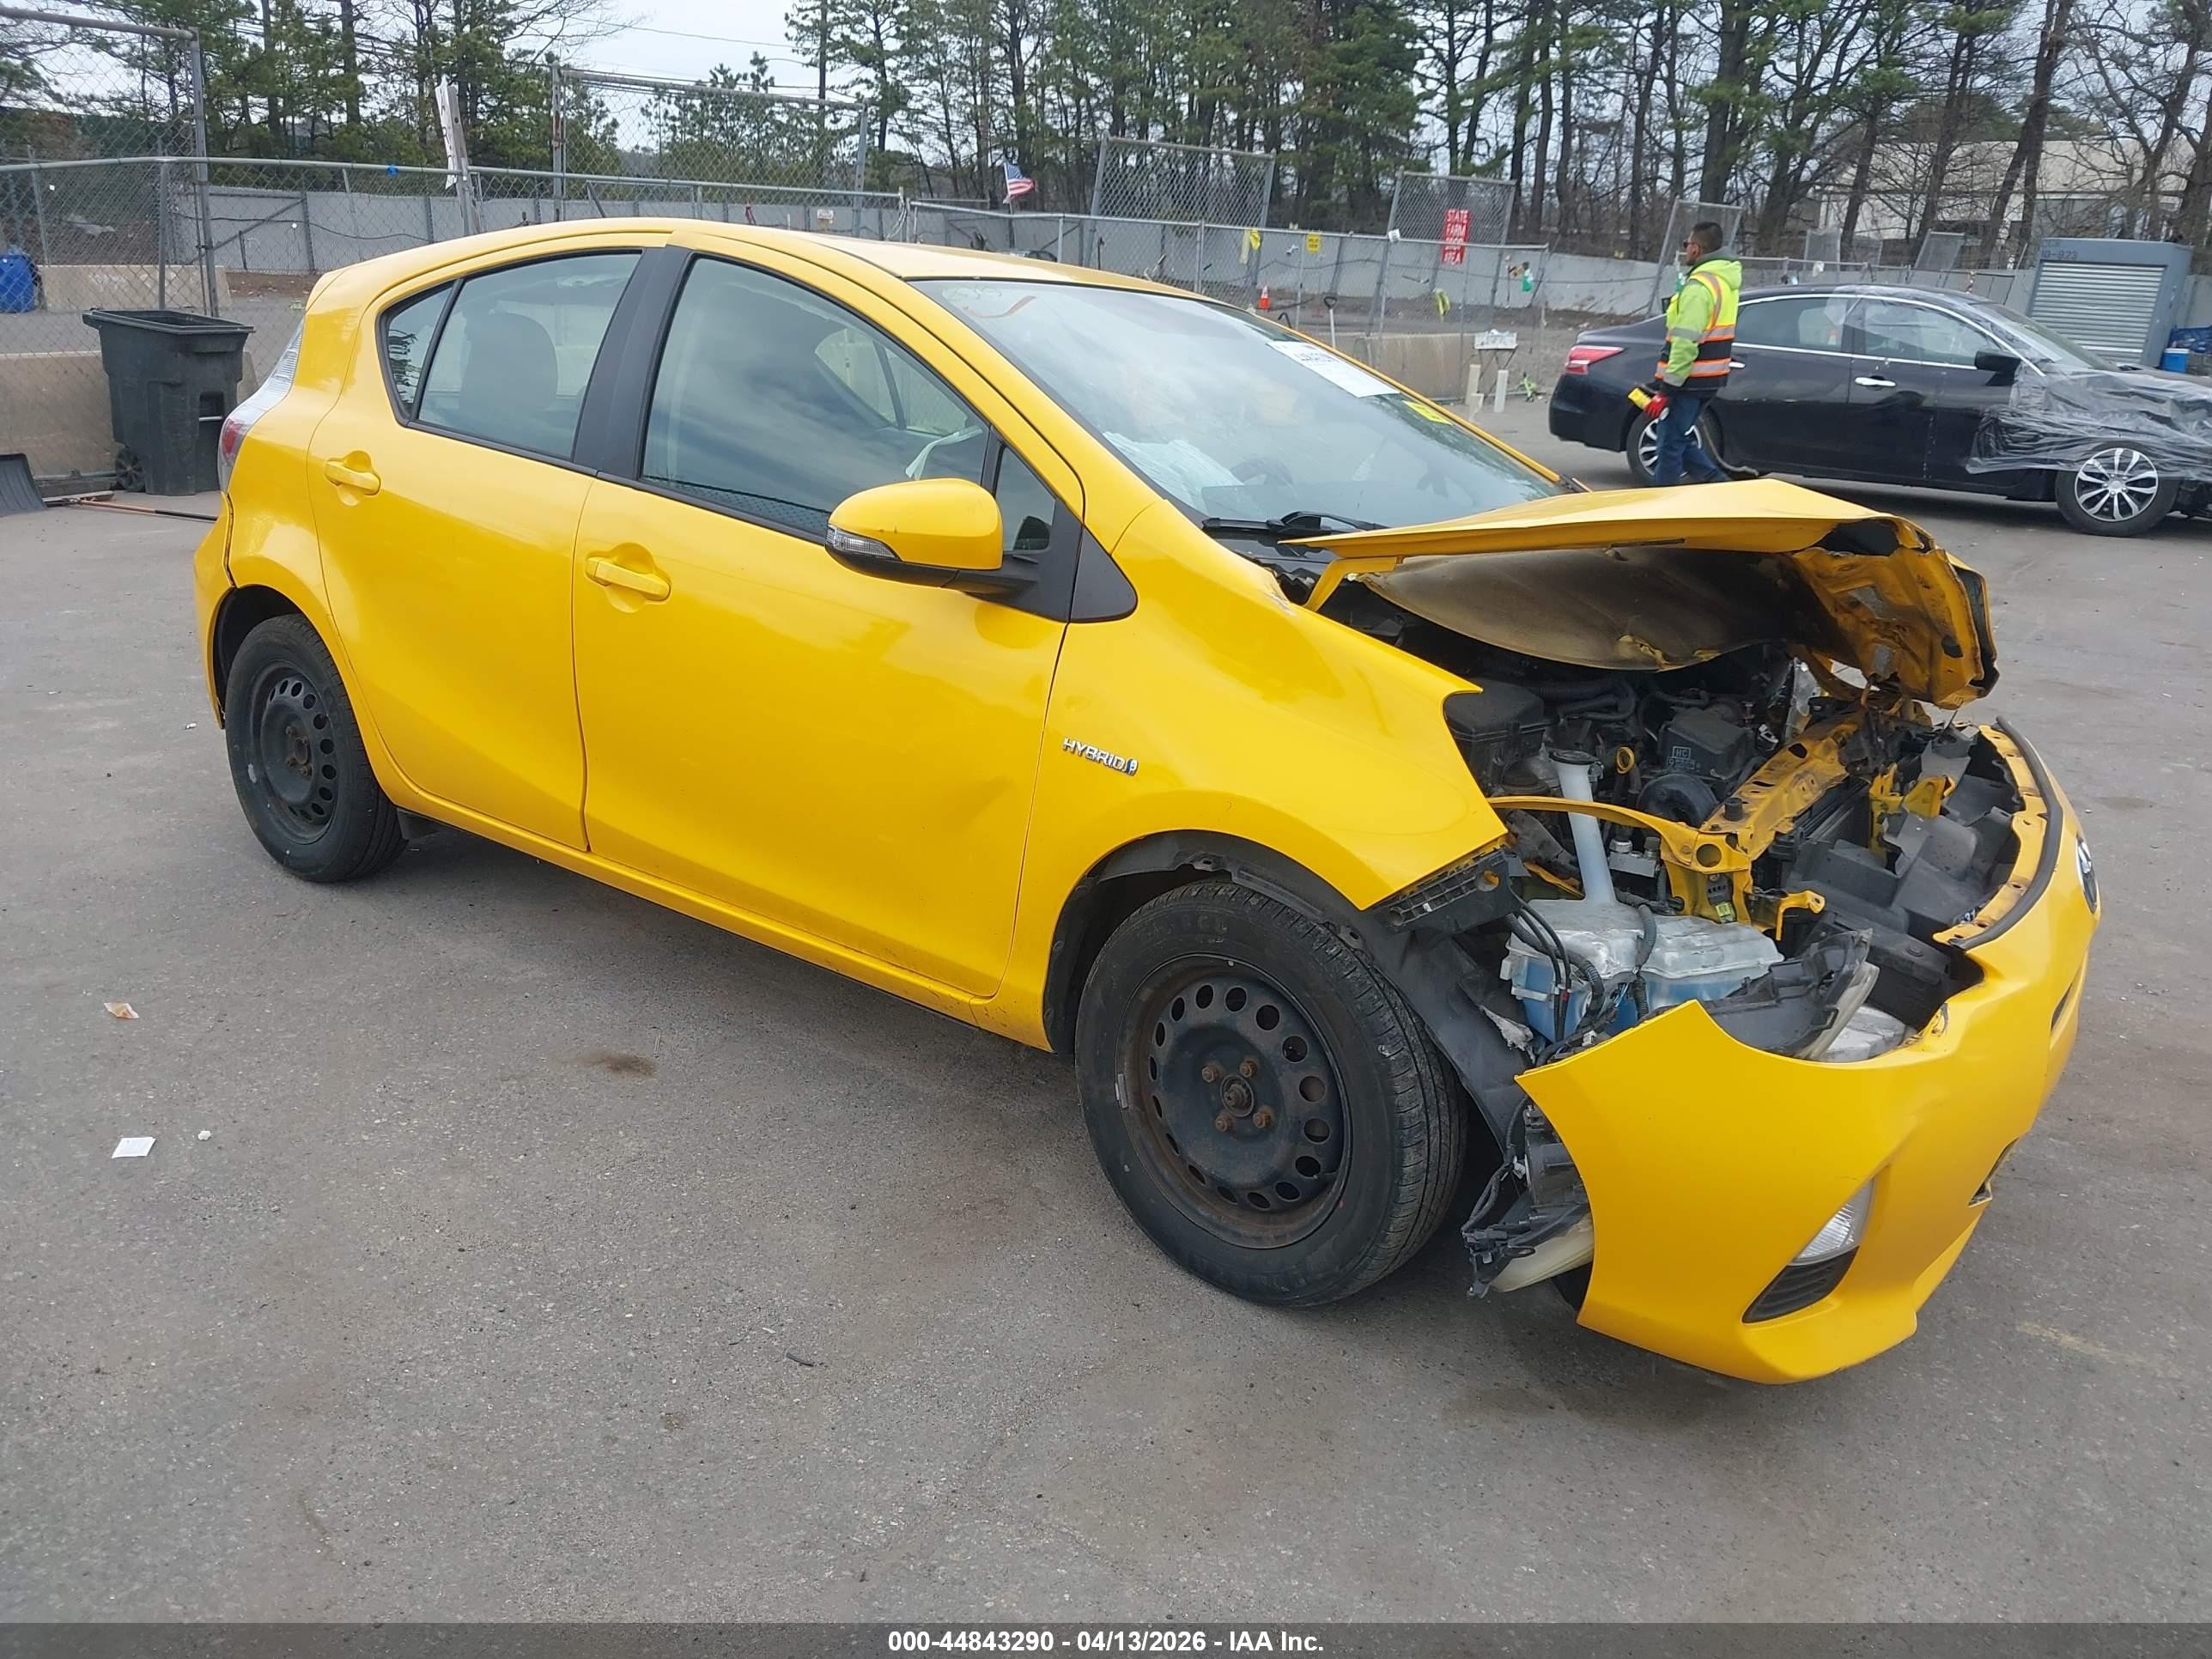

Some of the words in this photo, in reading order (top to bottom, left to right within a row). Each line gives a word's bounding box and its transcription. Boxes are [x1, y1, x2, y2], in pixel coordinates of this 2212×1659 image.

[1447, 210, 1468, 223] STATE
[1446, 223, 1467, 237] FARM
[1062, 738, 1126, 771] HYBRID
